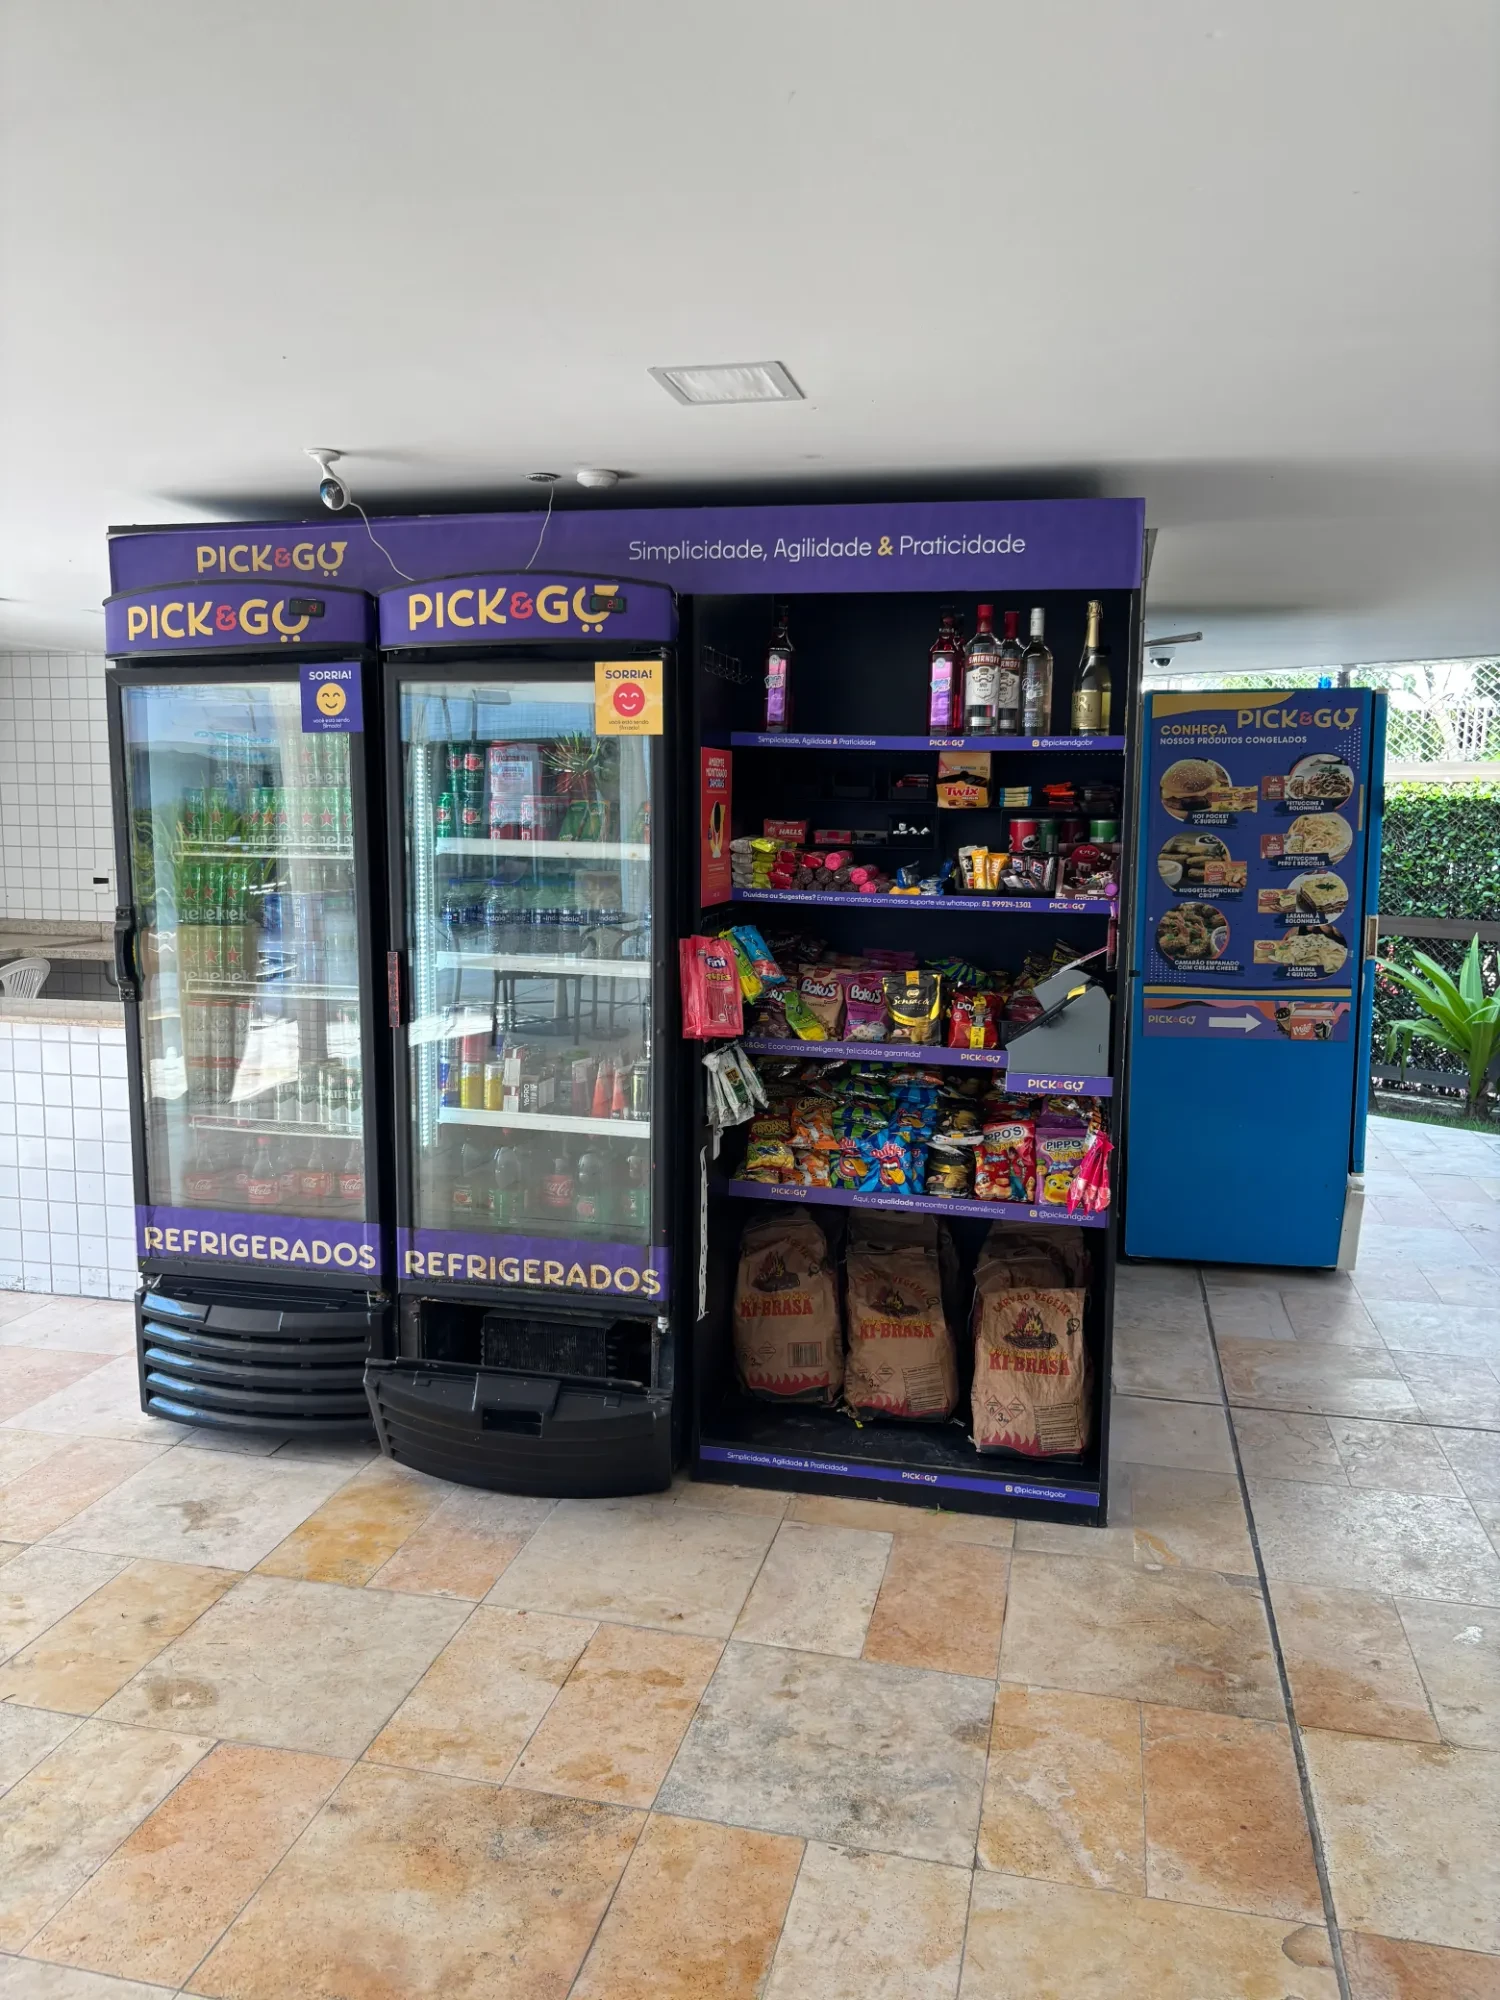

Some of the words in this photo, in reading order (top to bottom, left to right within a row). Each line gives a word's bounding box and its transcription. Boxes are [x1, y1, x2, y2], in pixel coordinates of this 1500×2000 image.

[628, 538, 768, 563] Simplicidade,
[773, 535, 872, 562] Agilidade
[877, 535, 894, 557] &
[899, 533, 1026, 557] Praticidade
[196, 541, 348, 577] PICK&GO
[308, 670, 352, 681] SORRIA!
[605, 669, 653, 680] SORRIA!
[1236, 708, 1359, 731] PICK&GO
[1160, 724, 1228, 738] CONHEÇA
[1159, 737, 1195, 745] NOSSOS
[1197, 736, 1243, 745] PRODUTOS
[1245, 735, 1307, 744] CONGELADOS
[945, 786, 979, 797] Twix
[742, 891, 769, 899] Dúvidas
[778, 892, 817, 902] Sugestões?
[767, 1042, 806, 1052] Economia
[1027, 1078, 1085, 1093] PICK&GO
[877, 1198, 914, 1207] qualidade
[144, 1226, 377, 1269] REFRIGERADOS
[404, 1249, 661, 1295] REFRIGERADOS
[989, 1353, 1071, 1376] KI-BRASA
